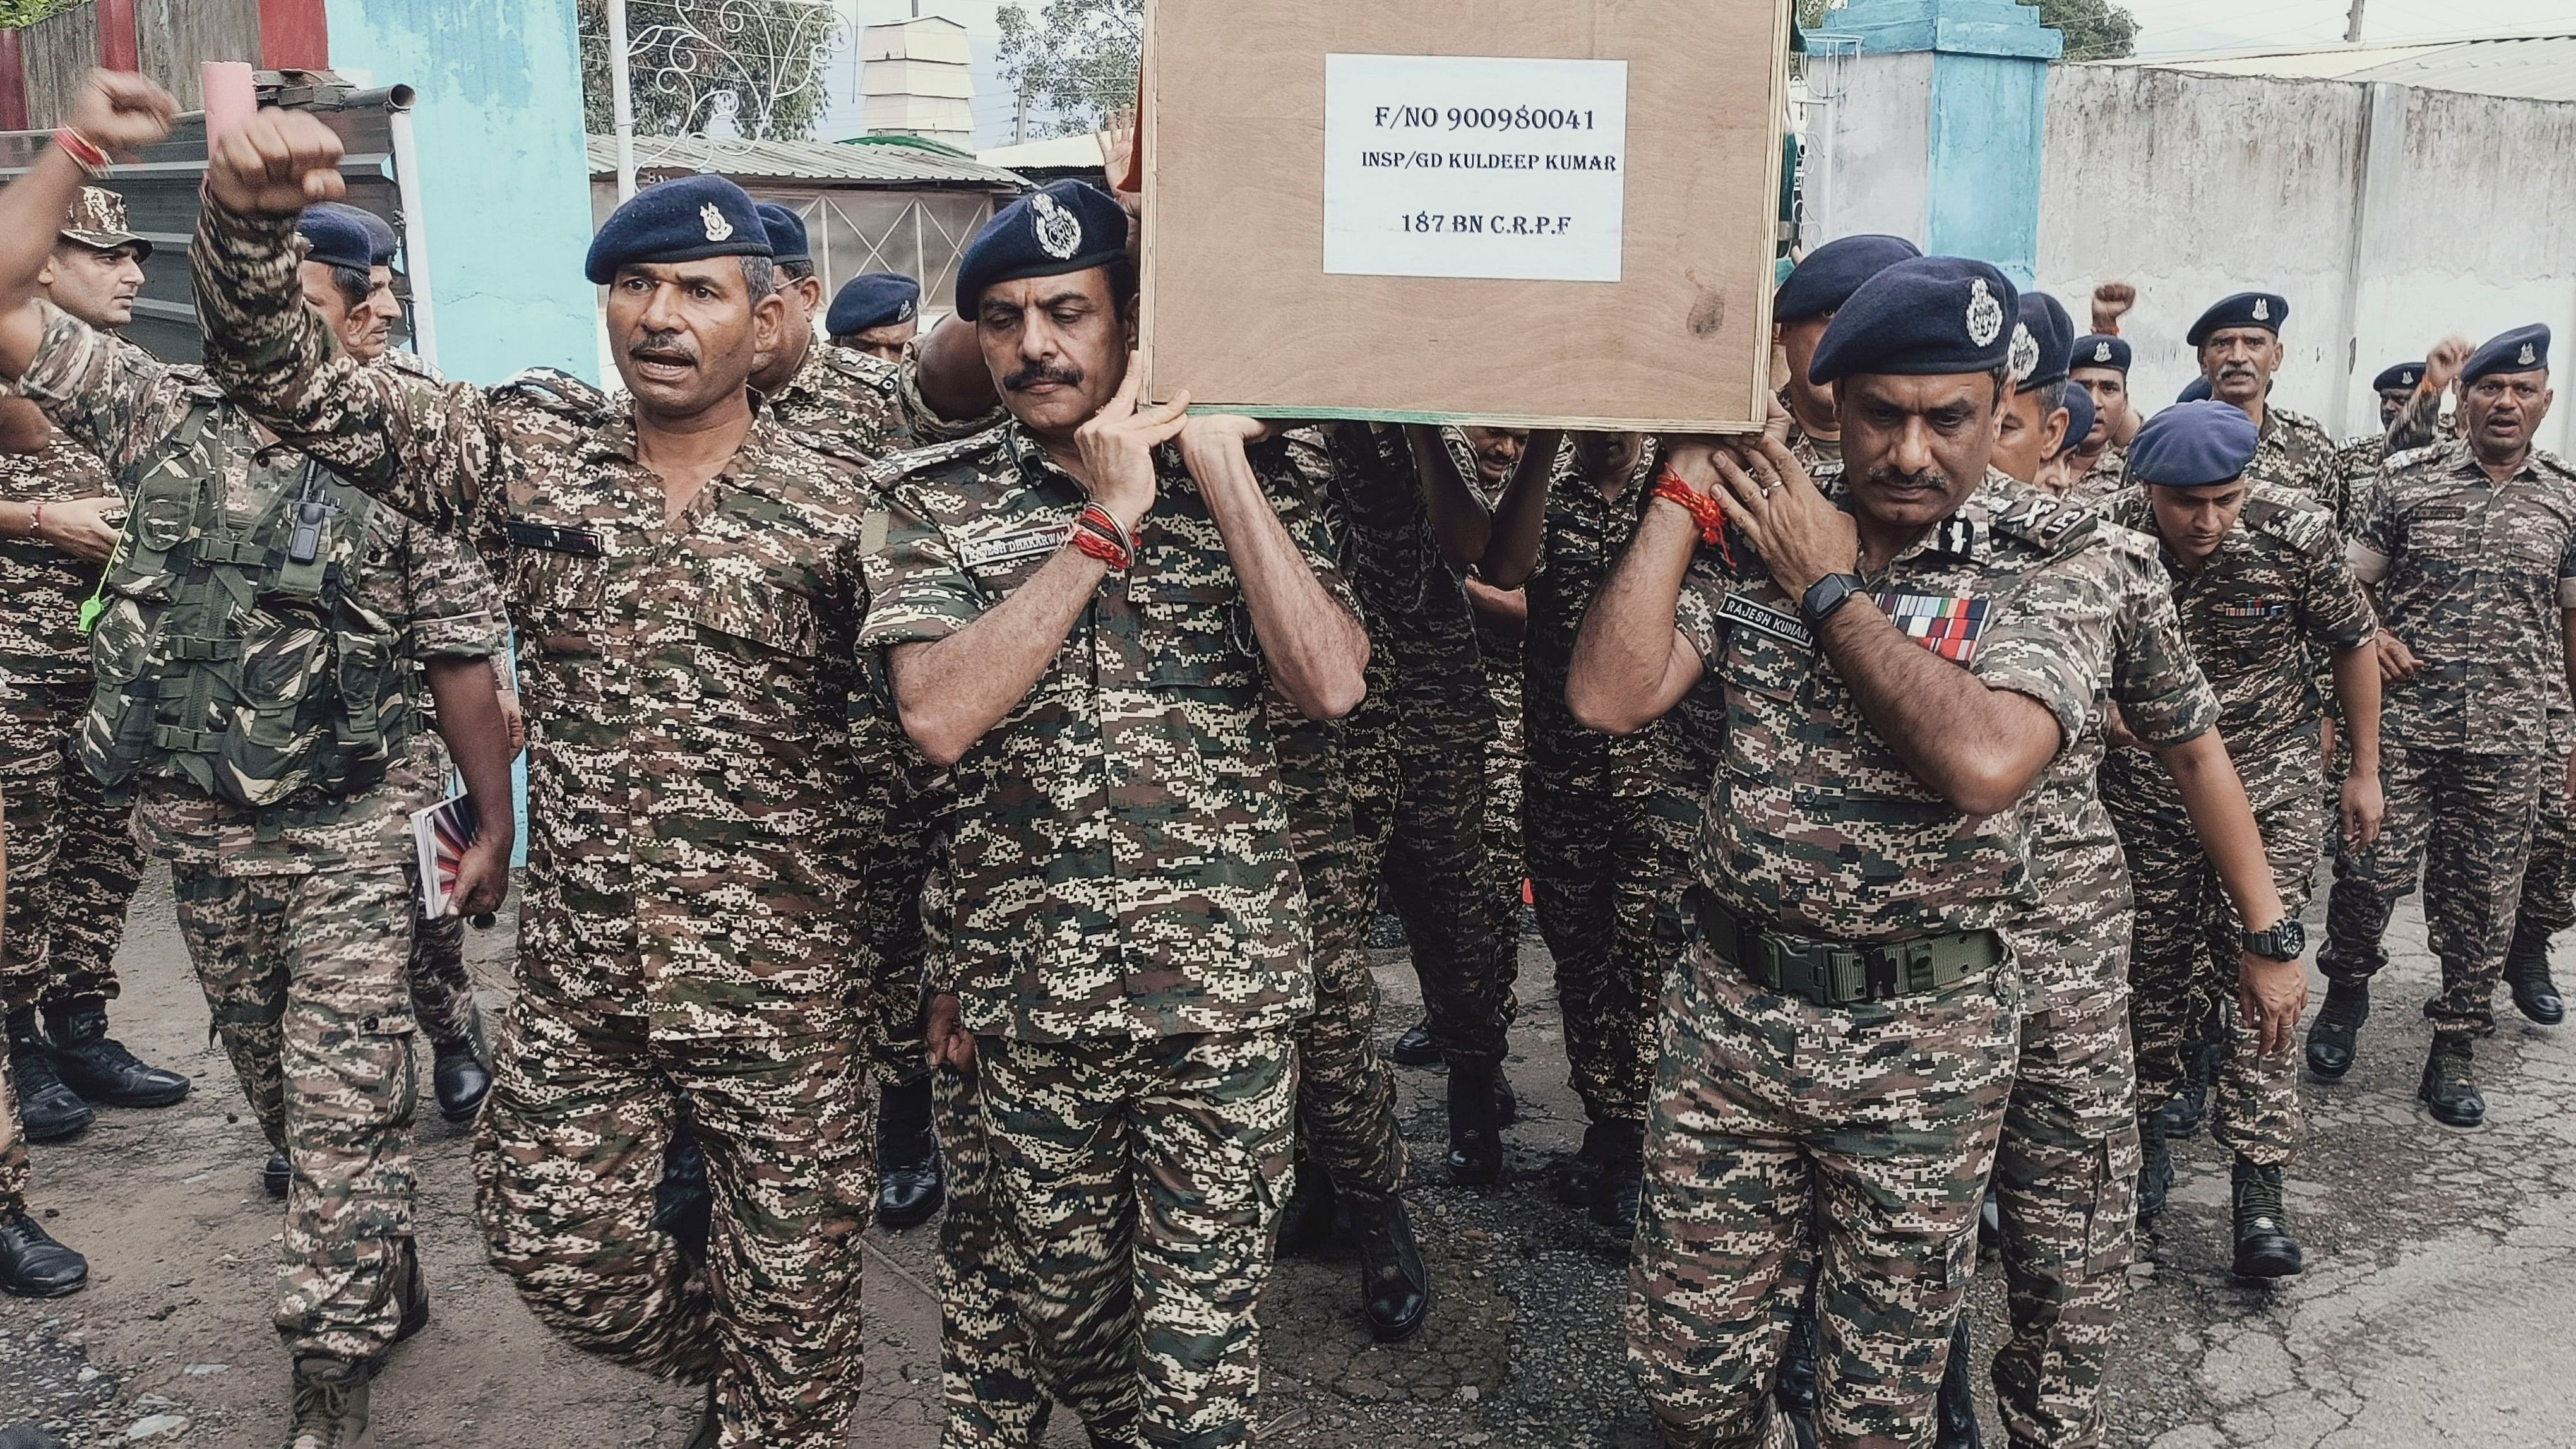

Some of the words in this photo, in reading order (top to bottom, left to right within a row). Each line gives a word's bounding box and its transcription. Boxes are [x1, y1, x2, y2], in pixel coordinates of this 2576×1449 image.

[1375, 105, 1438, 129] F/NO
[1447, 105, 1593, 131] 900980041
[1362, 151, 1443, 169] INSP/GD
[1449, 153, 1539, 169] KULDEEP
[1546, 155, 1616, 171] KUMAR
[1402, 211, 1445, 232] 187
[1452, 215, 1482, 233] BN
[1491, 215, 1571, 235] C.R.P.F
[2046, 510, 2081, 533] IPS
[1726, 600, 1772, 626] RAJESH
